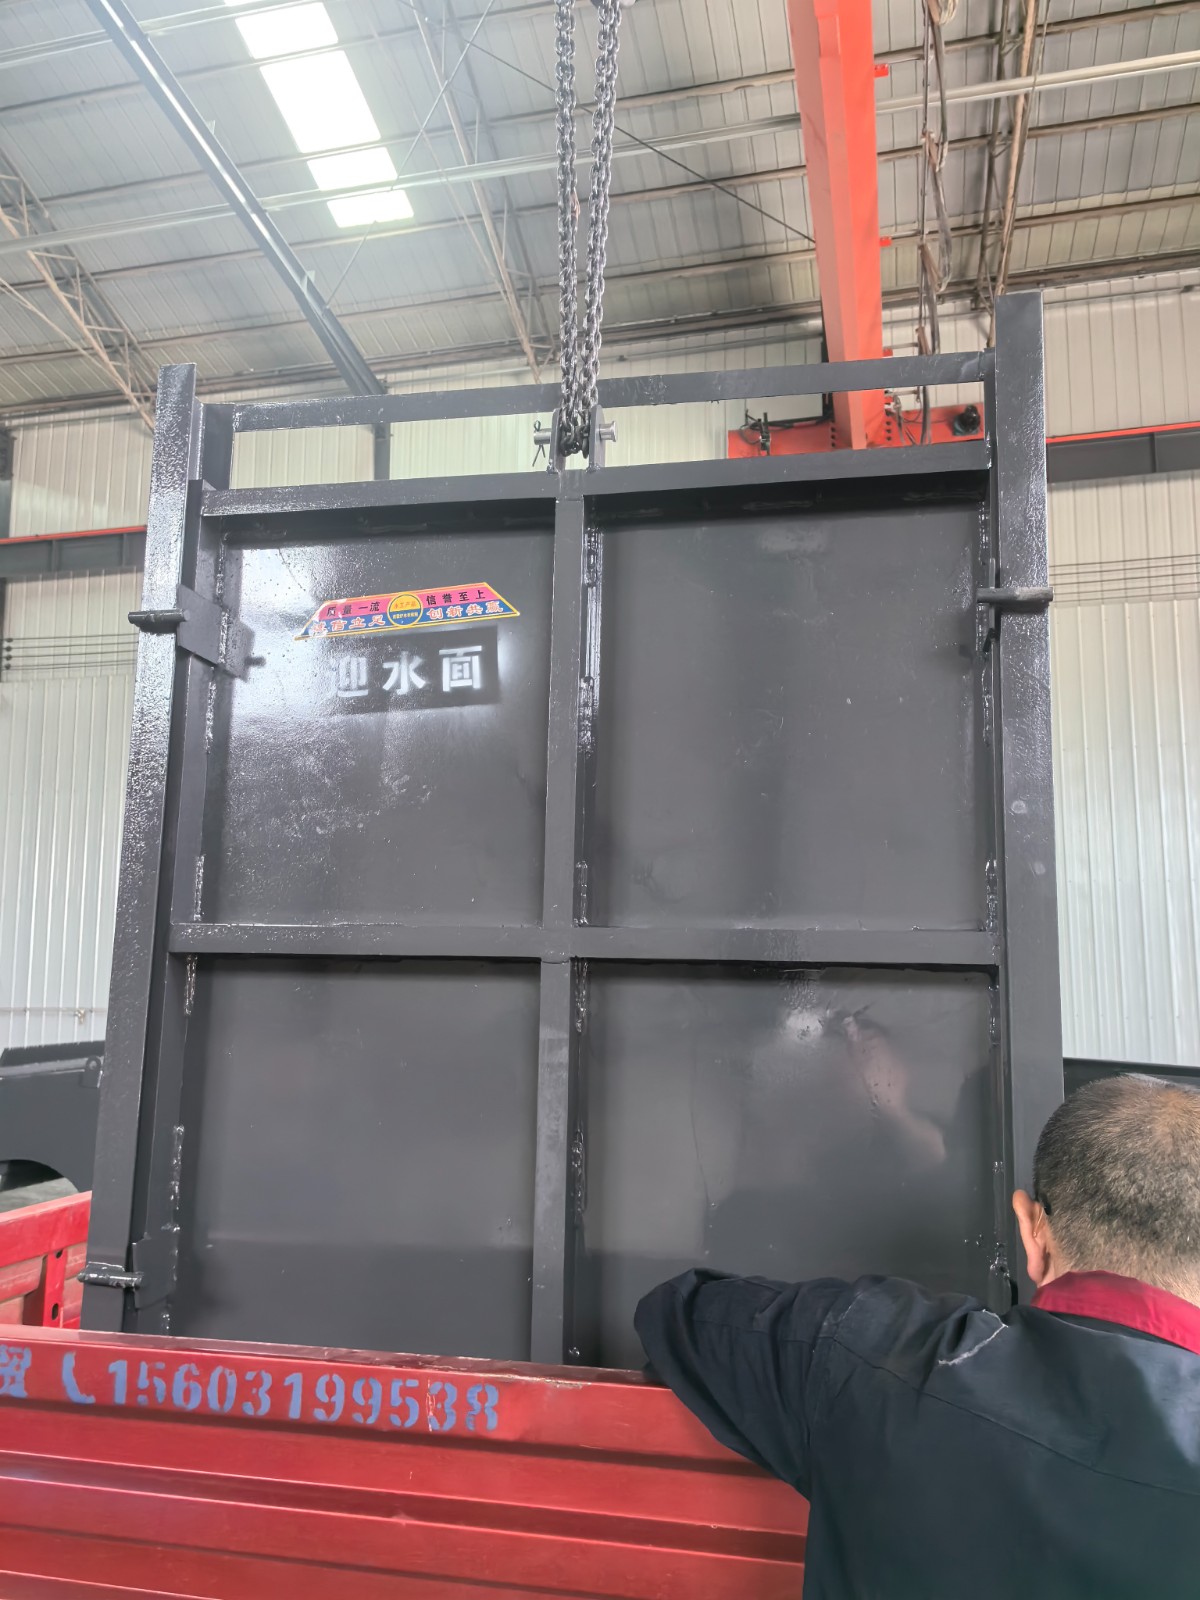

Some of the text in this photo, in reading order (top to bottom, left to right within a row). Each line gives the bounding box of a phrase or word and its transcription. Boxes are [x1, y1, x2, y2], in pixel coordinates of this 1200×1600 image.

[312, 614, 386, 633] 诚信立足
[426, 601, 503, 619] 创新共赢
[327, 602, 380, 616] 质量一流
[426, 590, 486, 605] 信誉至上
[330, 645, 483, 697] 迎水面
[108, 1359, 499, 1432] 15603199538
